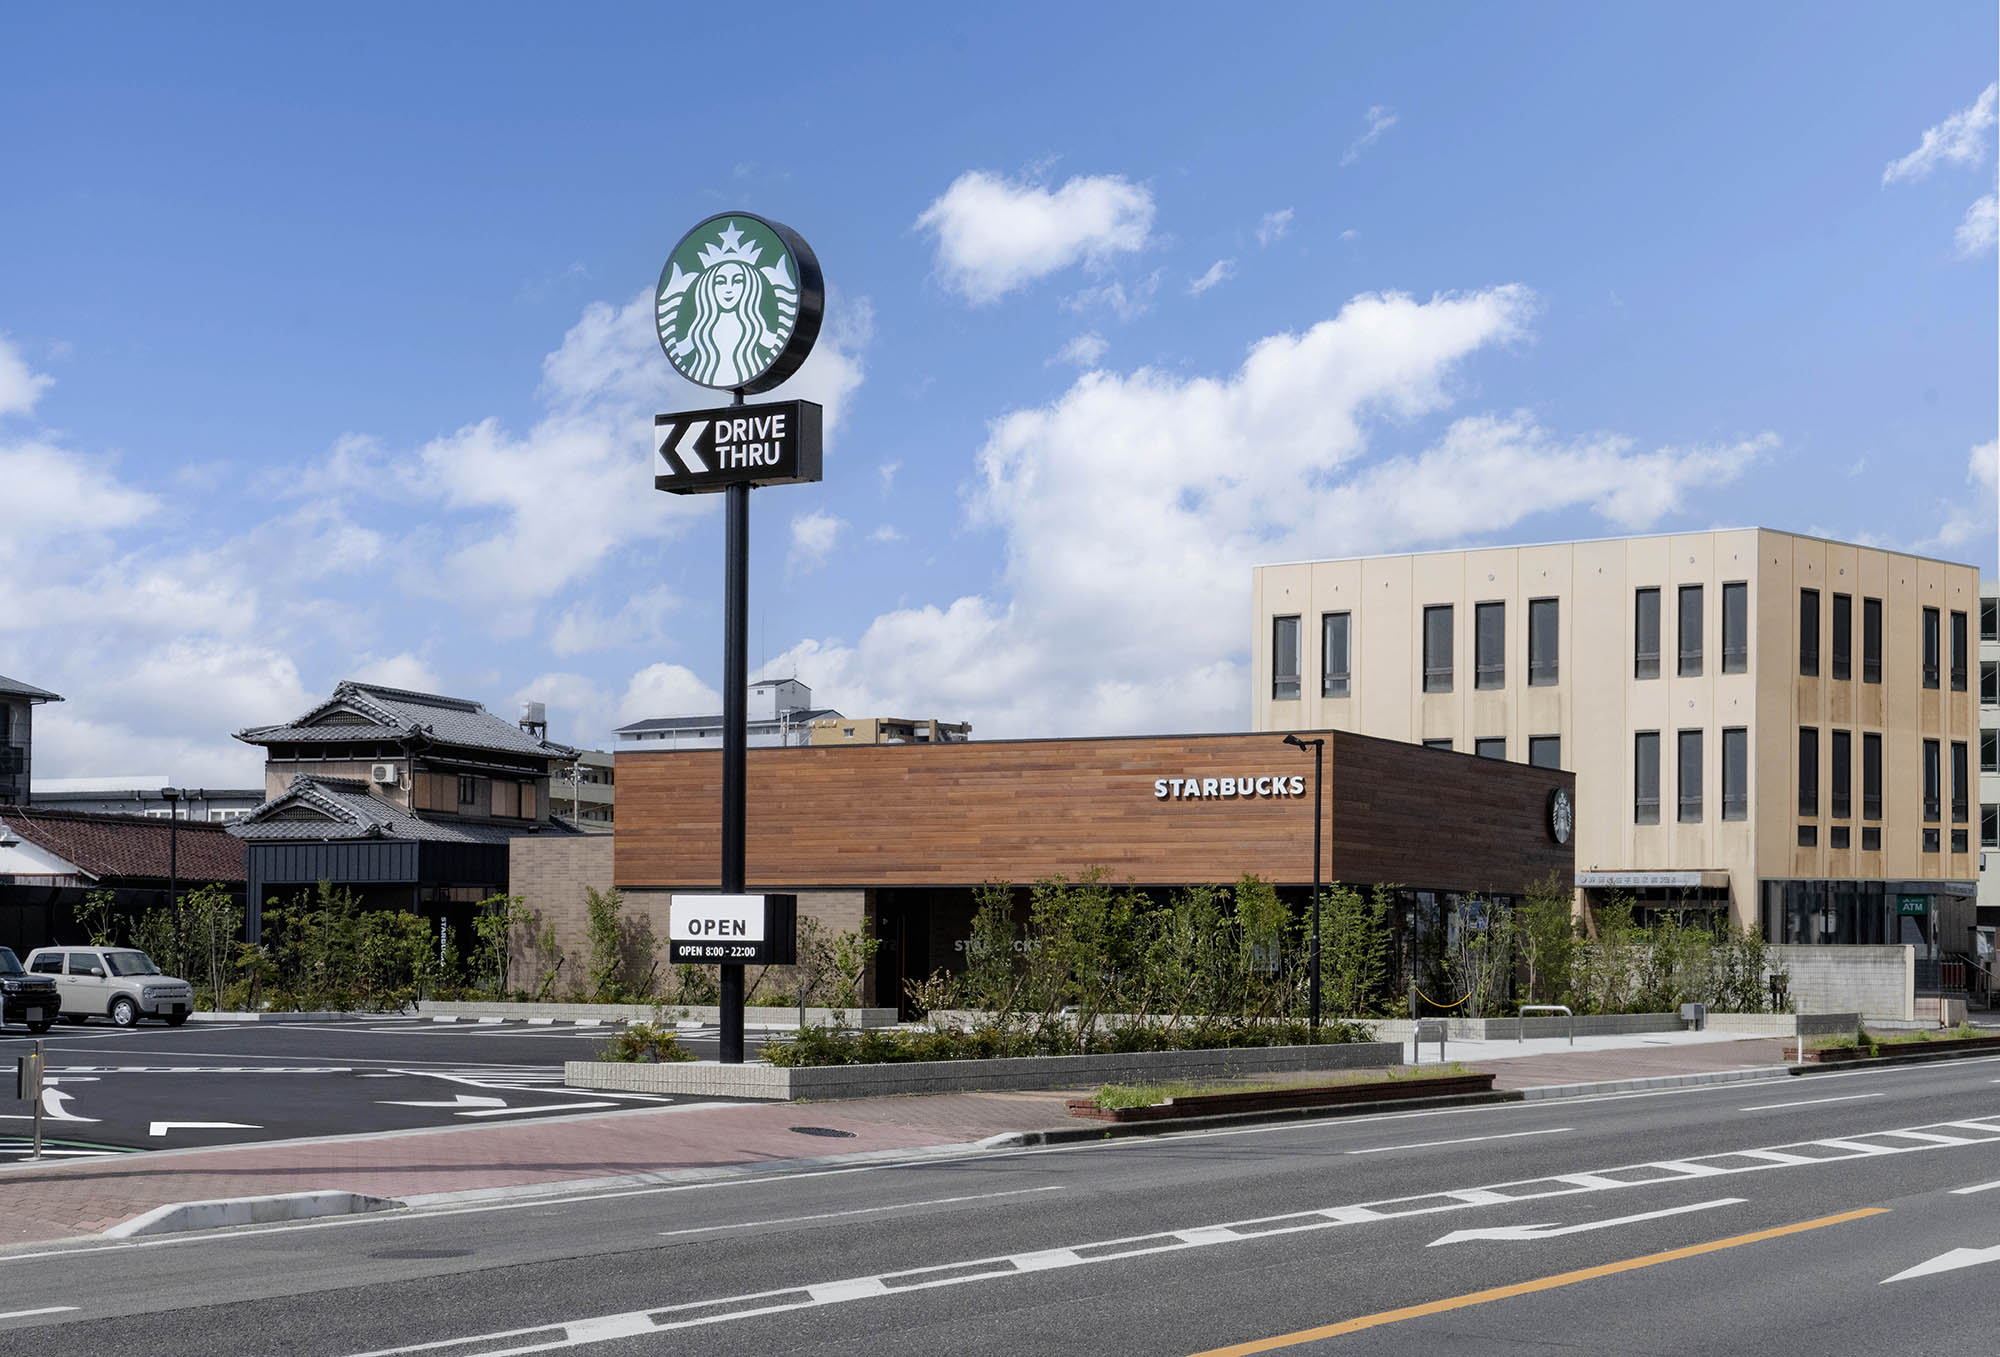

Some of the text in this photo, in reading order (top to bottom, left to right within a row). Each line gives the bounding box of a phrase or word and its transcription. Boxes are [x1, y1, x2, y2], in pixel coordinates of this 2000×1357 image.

[715, 414, 786, 444] DRIVE
[715, 441, 780, 469] THRU
[1154, 776, 1305, 798] STARBUCKS
[1902, 903, 1923, 912] ATM
[688, 919, 746, 936] OPEN
[679, 946, 703, 957] OPEN
